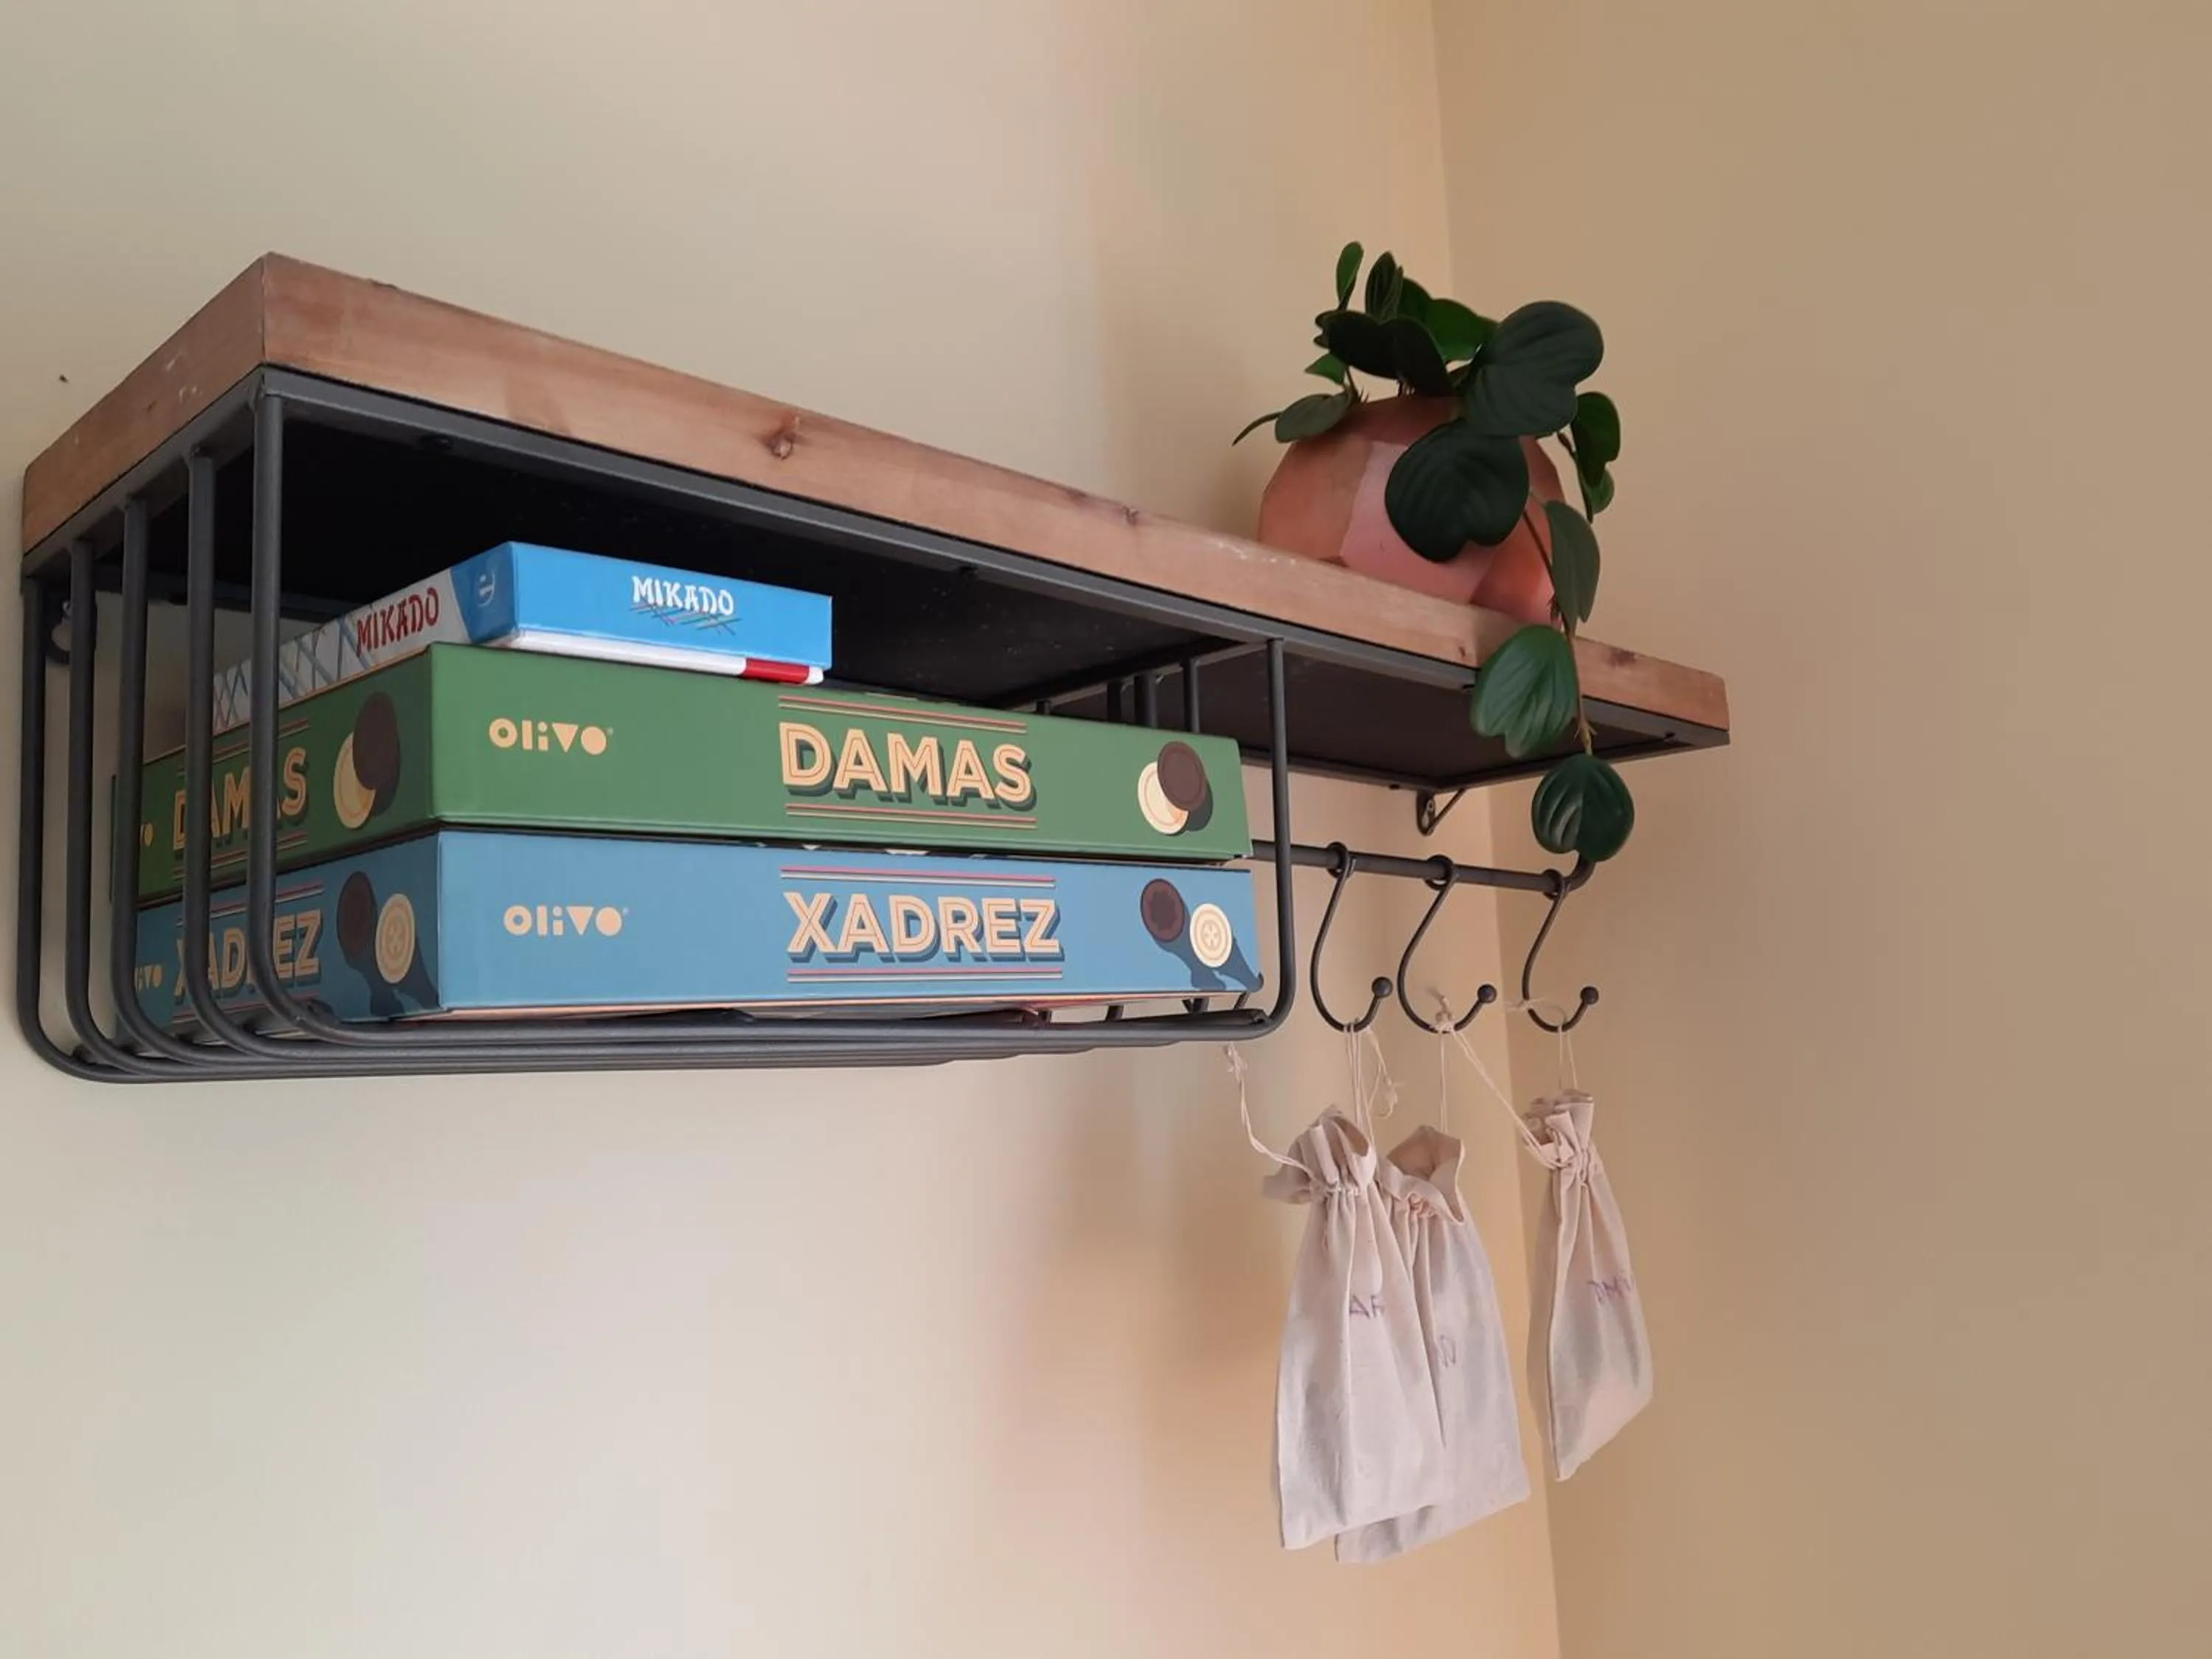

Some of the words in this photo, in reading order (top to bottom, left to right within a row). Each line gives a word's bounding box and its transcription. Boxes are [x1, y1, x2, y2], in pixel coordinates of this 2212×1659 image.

[356, 587, 439, 656] MIKADO
[632, 575, 735, 616] MIKADO
[779, 722, 1035, 810] DAMAS
[784, 891, 1062, 959] XADREZ
